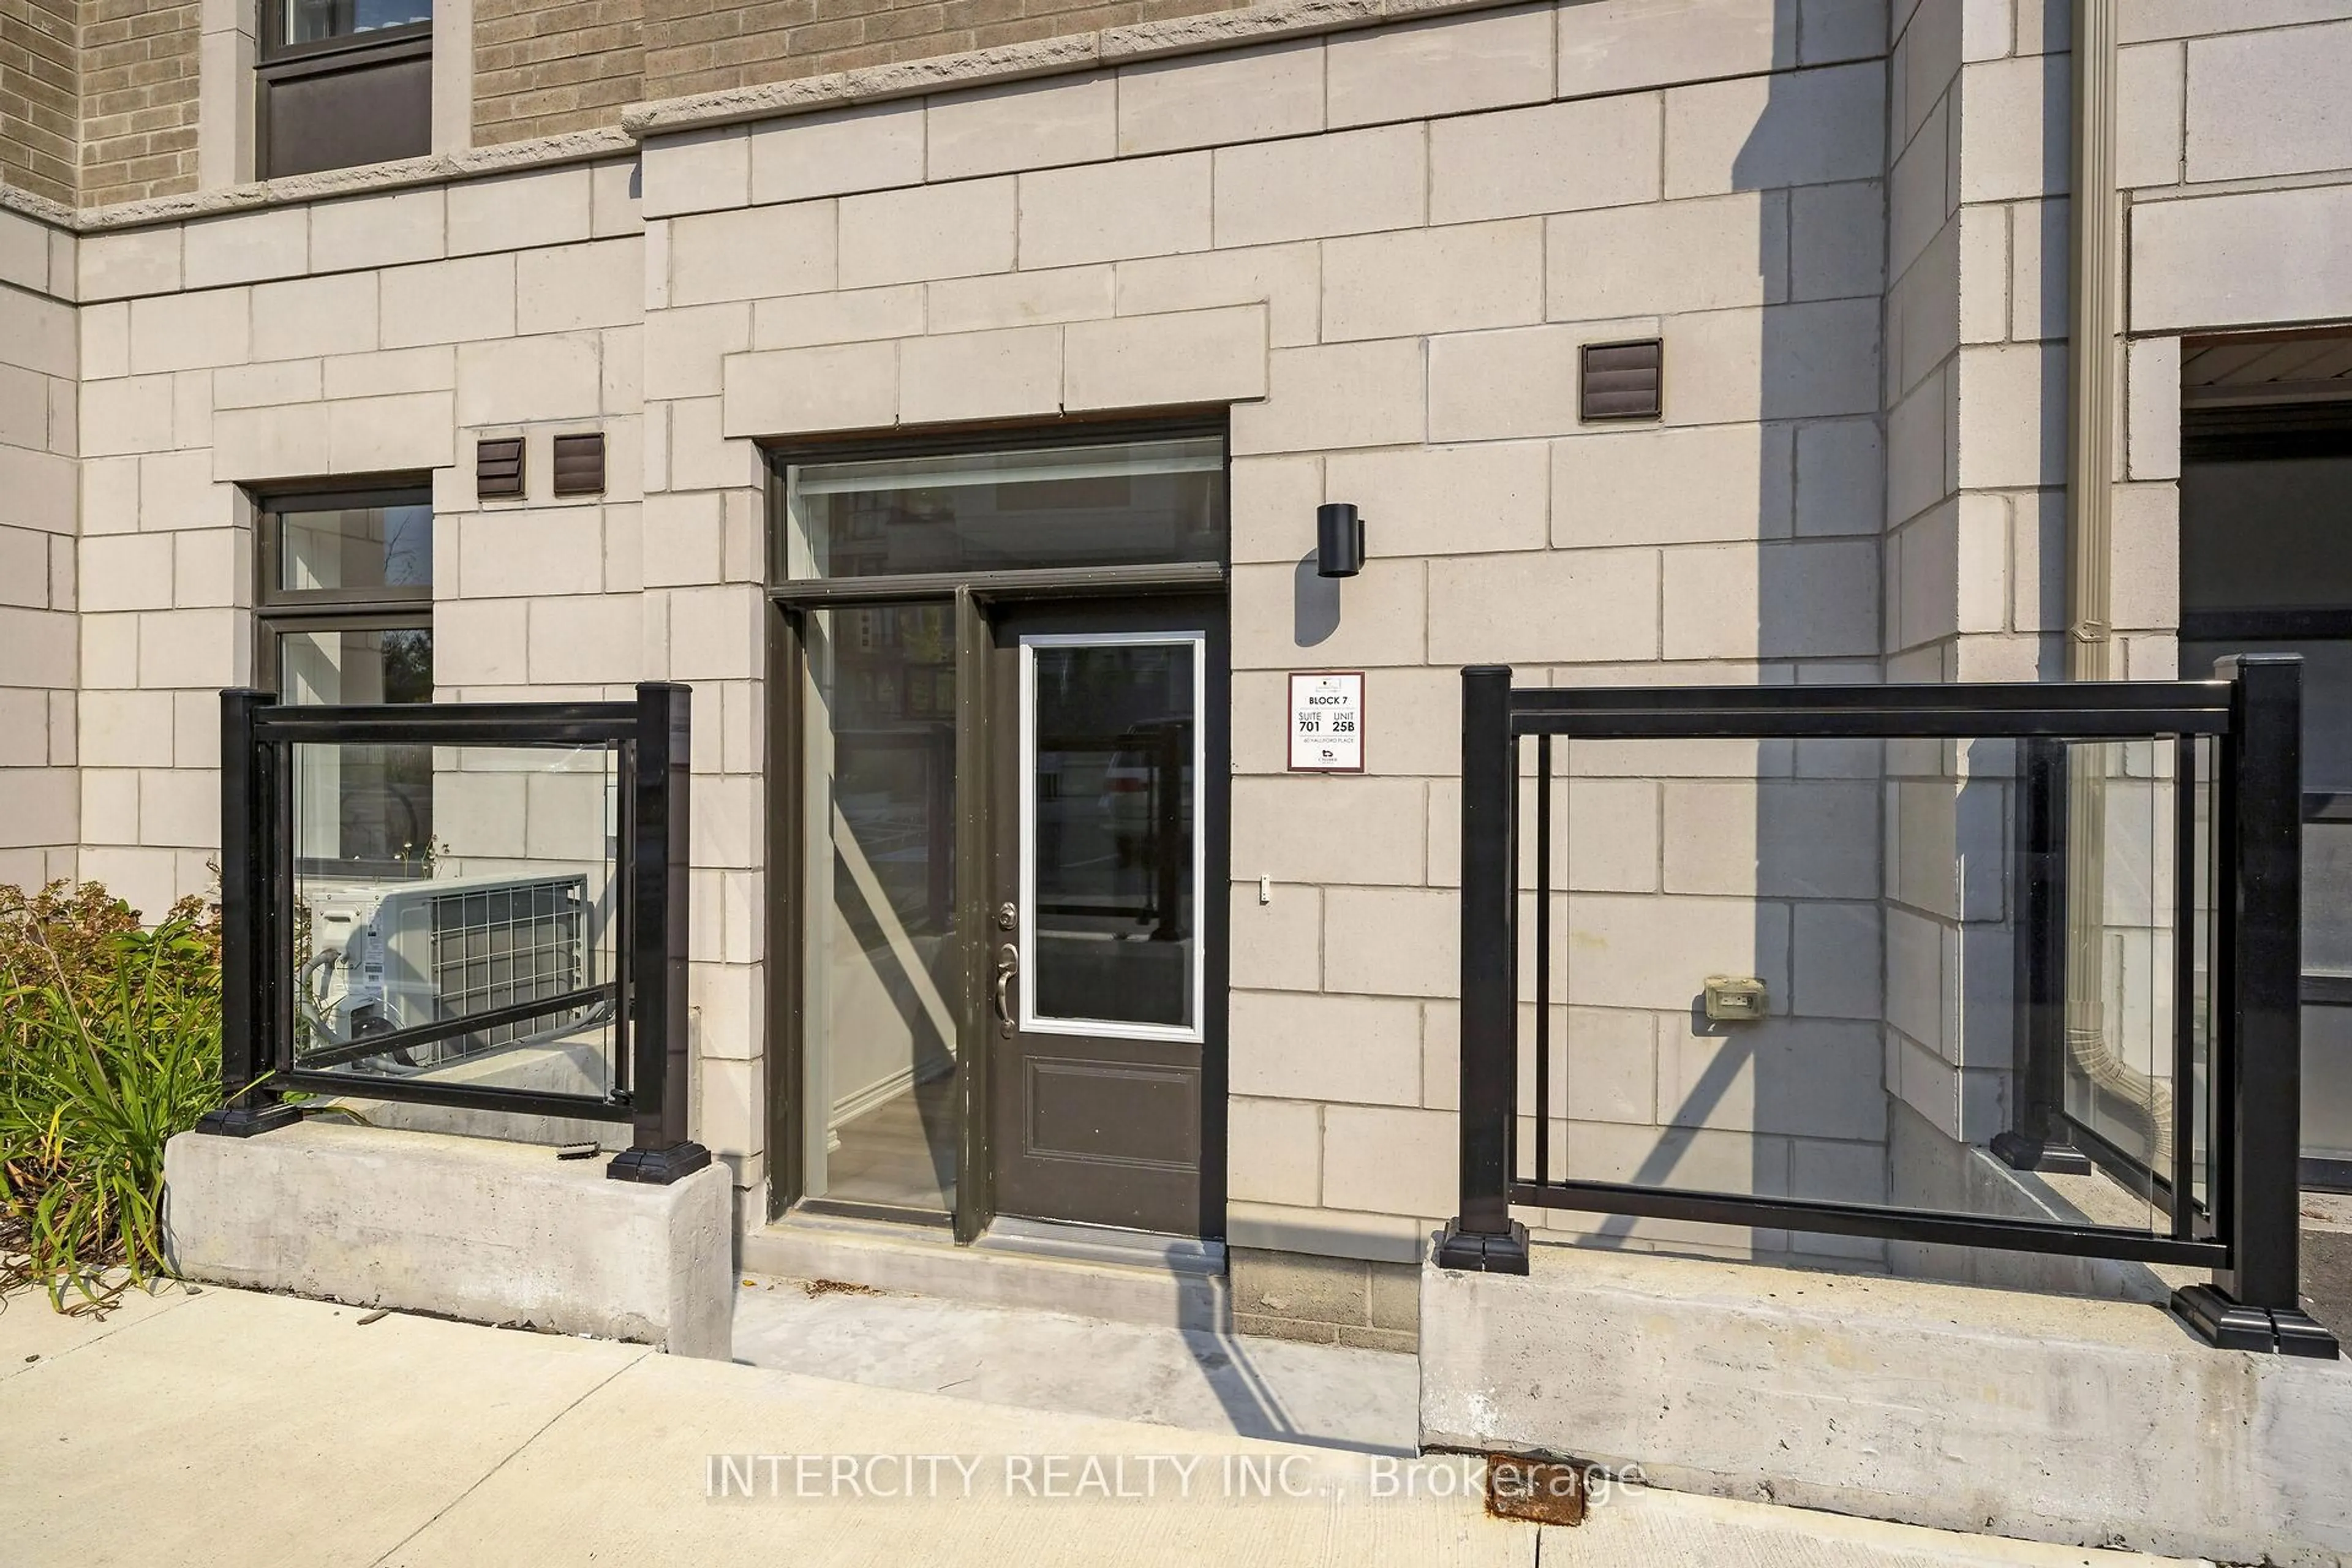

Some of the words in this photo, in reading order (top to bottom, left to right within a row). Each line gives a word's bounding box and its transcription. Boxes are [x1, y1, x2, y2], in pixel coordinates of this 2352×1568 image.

[1298, 712, 1321, 720] SUITE
[1334, 712, 1354, 720] UNIT
[1300, 722, 1319, 731] 701
[1333, 722, 1355, 731] 25B
